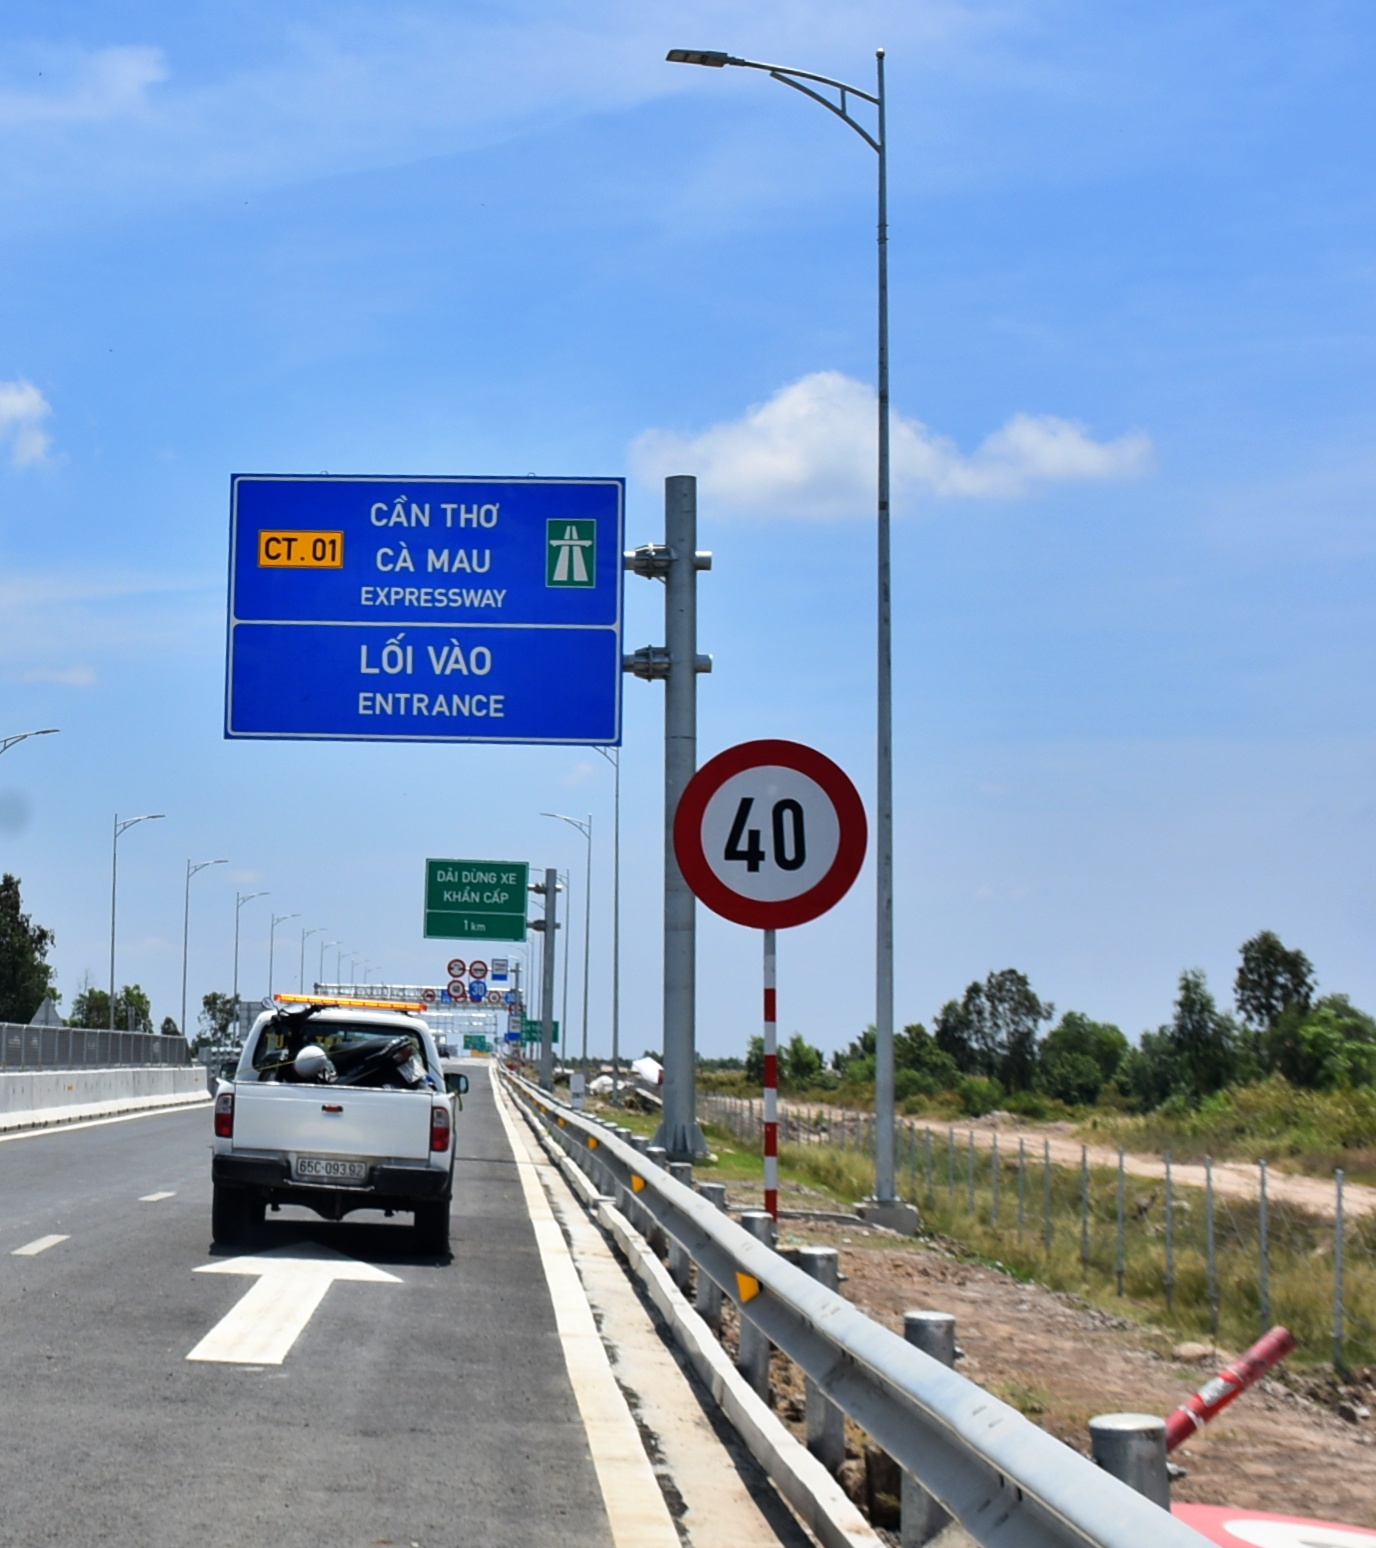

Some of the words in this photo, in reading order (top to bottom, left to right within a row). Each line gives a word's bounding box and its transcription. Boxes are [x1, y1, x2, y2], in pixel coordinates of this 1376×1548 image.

[370, 495, 430, 528] CẦN
[440, 503, 500, 528] THƠ
[376, 541, 415, 572] CÀ
[427, 549, 491, 573] MAU
[361, 586, 507, 608] EXPRESSWAY
[360, 632, 413, 675] LỐI
[427, 638, 492, 676] VÀO
[358, 692, 505, 717] ENTRANCE
[723, 797, 807, 873] 40
[436, 867, 458, 883] DẢI
[500, 873, 517, 885] XE
[443, 886, 480, 903] KHẨN
[483, 888, 509, 904] CẤP
[463, 919, 469, 931] 1
[470, 921, 486, 932] km
[471, 983, 485, 996] 30
